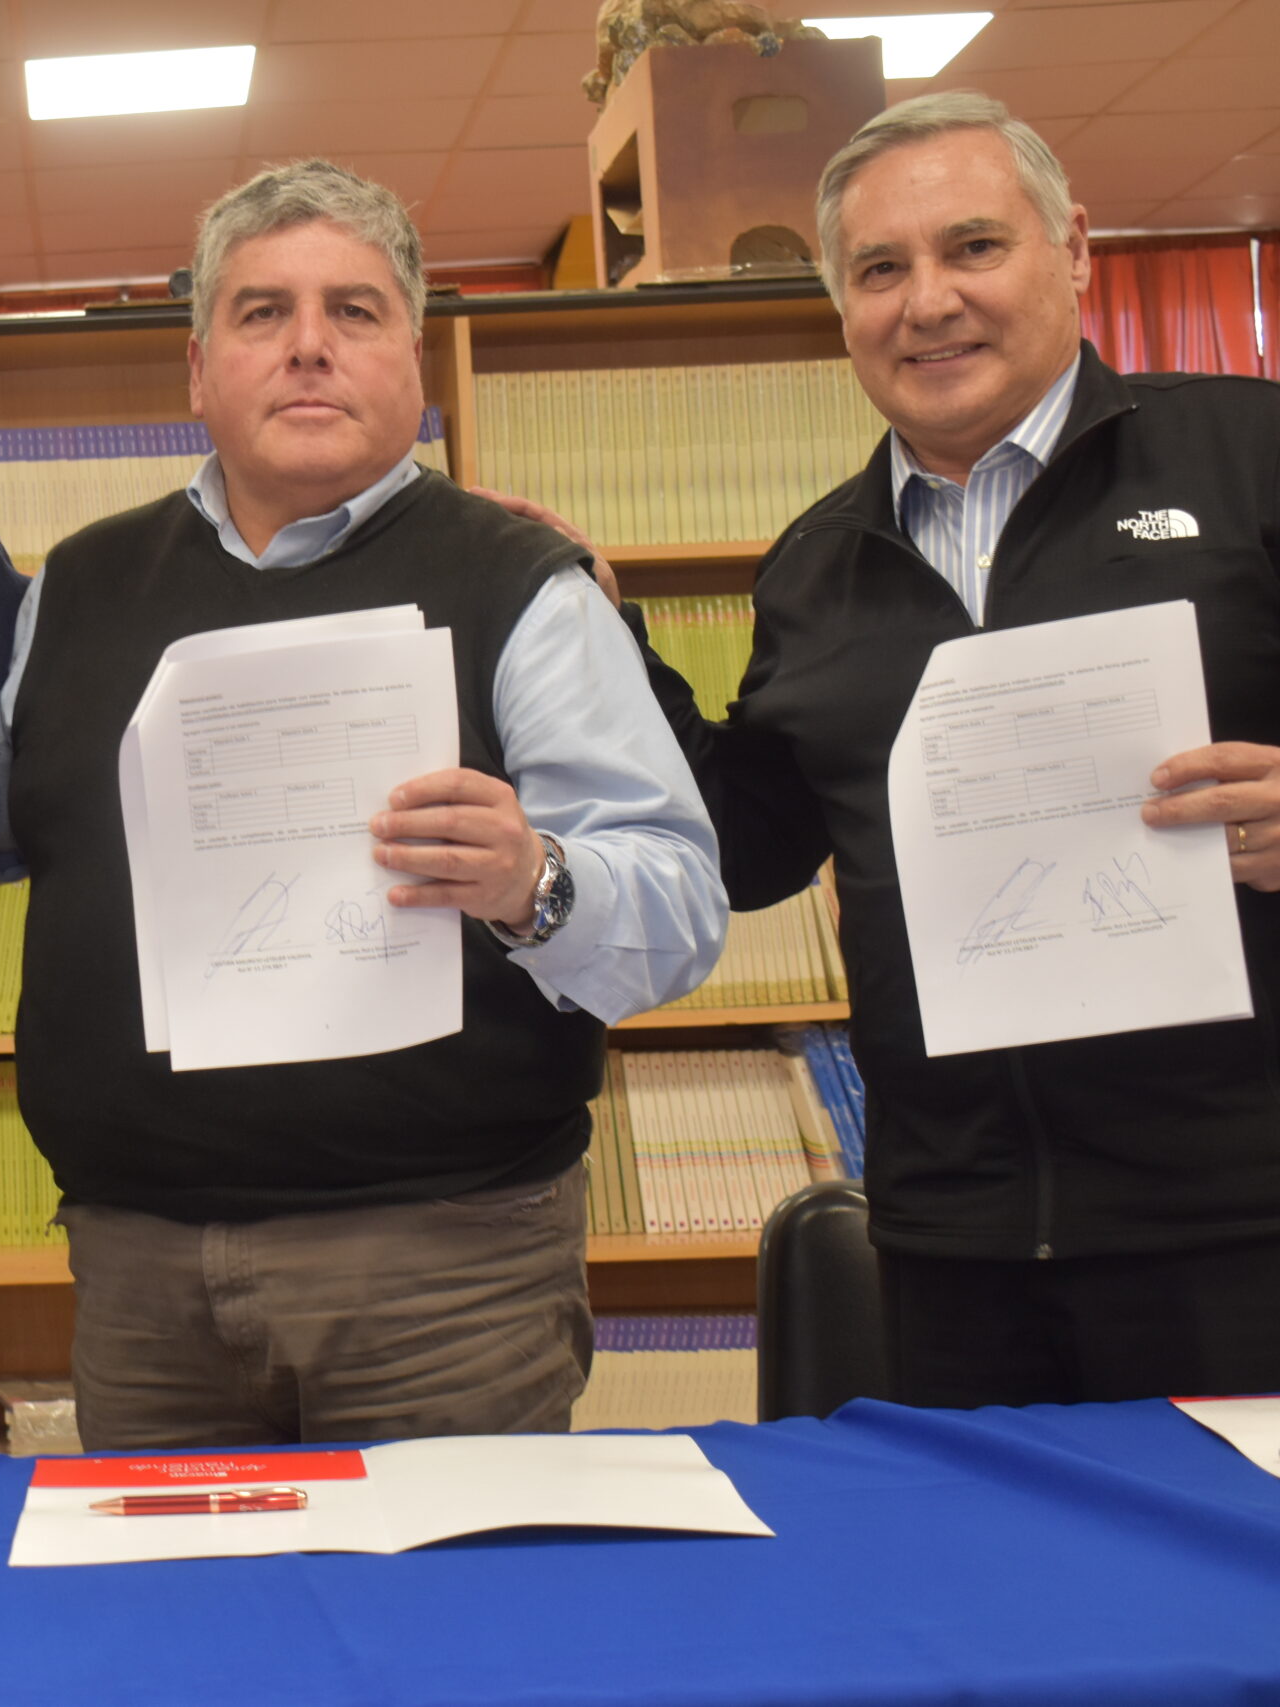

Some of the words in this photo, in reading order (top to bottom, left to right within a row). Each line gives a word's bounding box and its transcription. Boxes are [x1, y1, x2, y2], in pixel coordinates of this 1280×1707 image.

[1138, 510, 1168, 522] THE
[1116, 519, 1169, 532] NORTH
[1132, 529, 1170, 540] FACE
